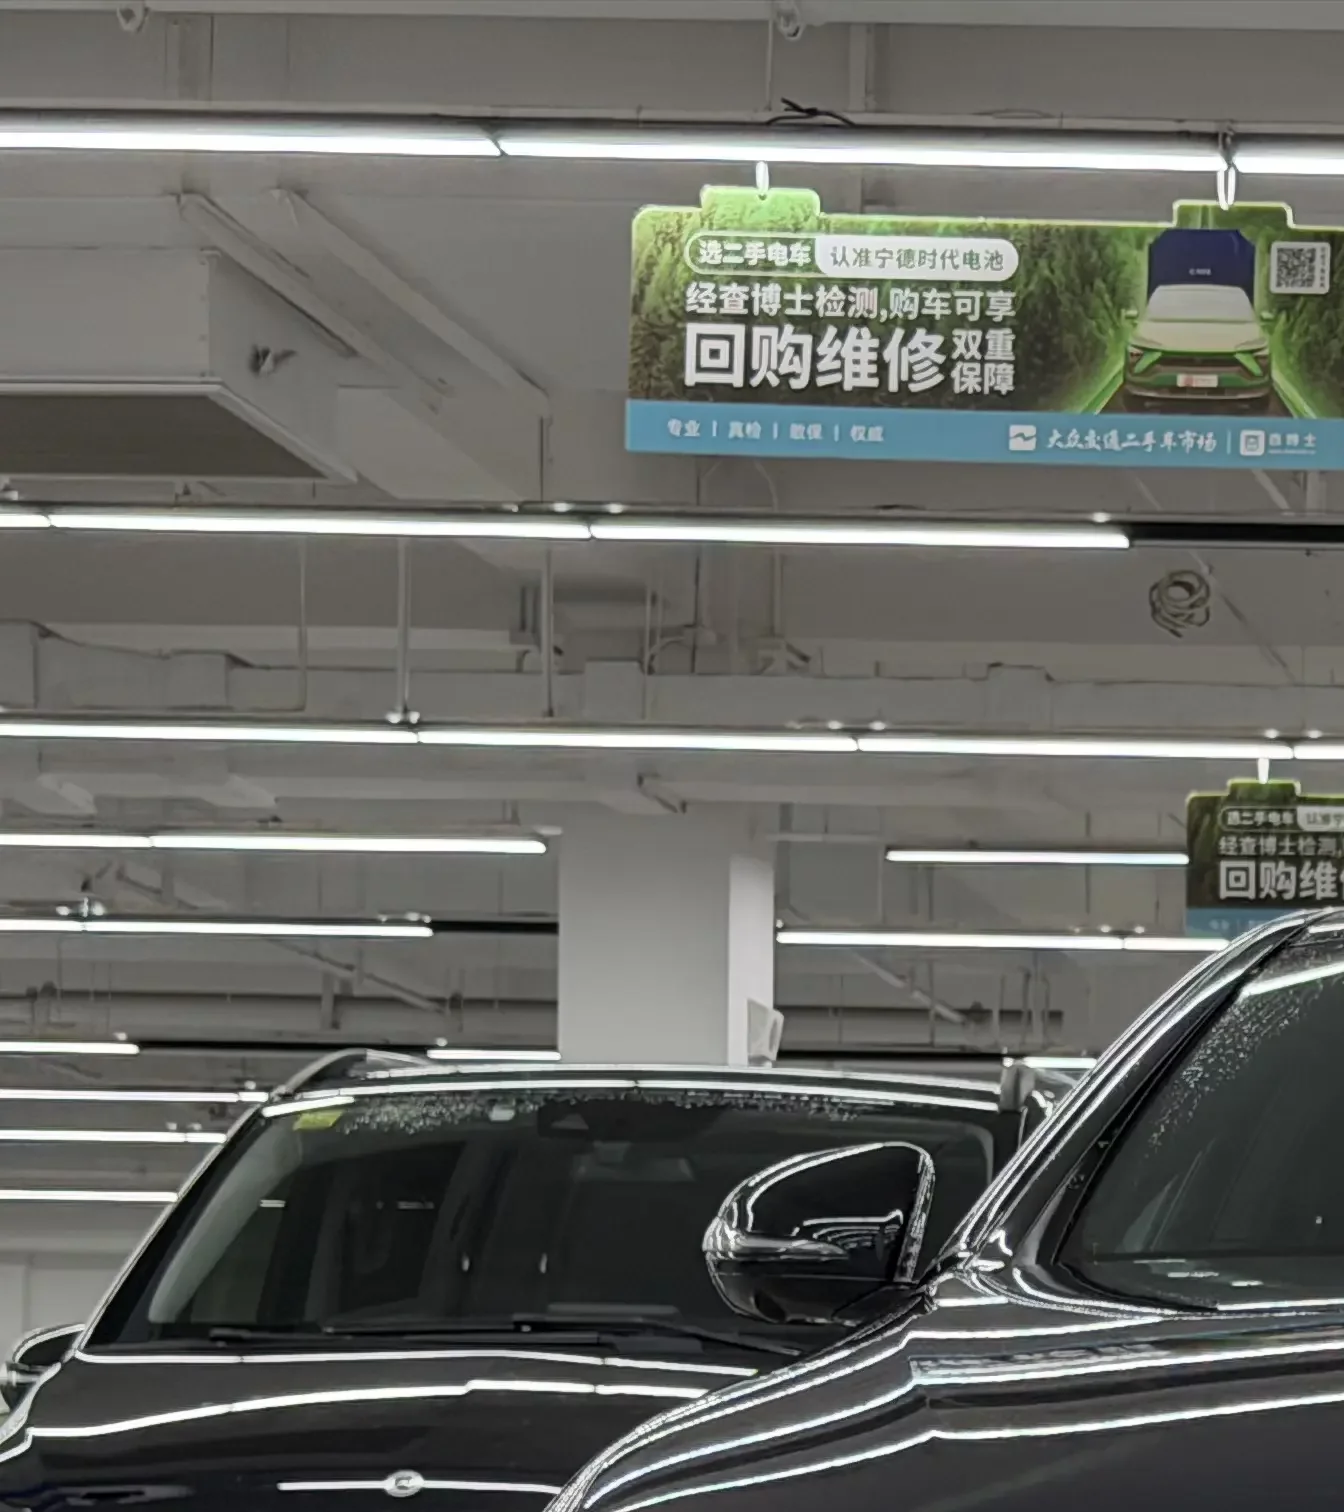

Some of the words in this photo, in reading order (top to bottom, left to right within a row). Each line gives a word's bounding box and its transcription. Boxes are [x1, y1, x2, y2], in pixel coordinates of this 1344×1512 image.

[699, 240, 811, 267] 选二手电车
[831, 246, 1005, 271] 认准宁德时代电池
[686, 281, 1016, 323] 经查博士检测,购车可享
[684, 322, 946, 393] 回购维修
[951, 328, 1016, 362] 双重
[950, 361, 1015, 396] 保障
[1045, 428, 1218, 454] 大众交通二手车市场
